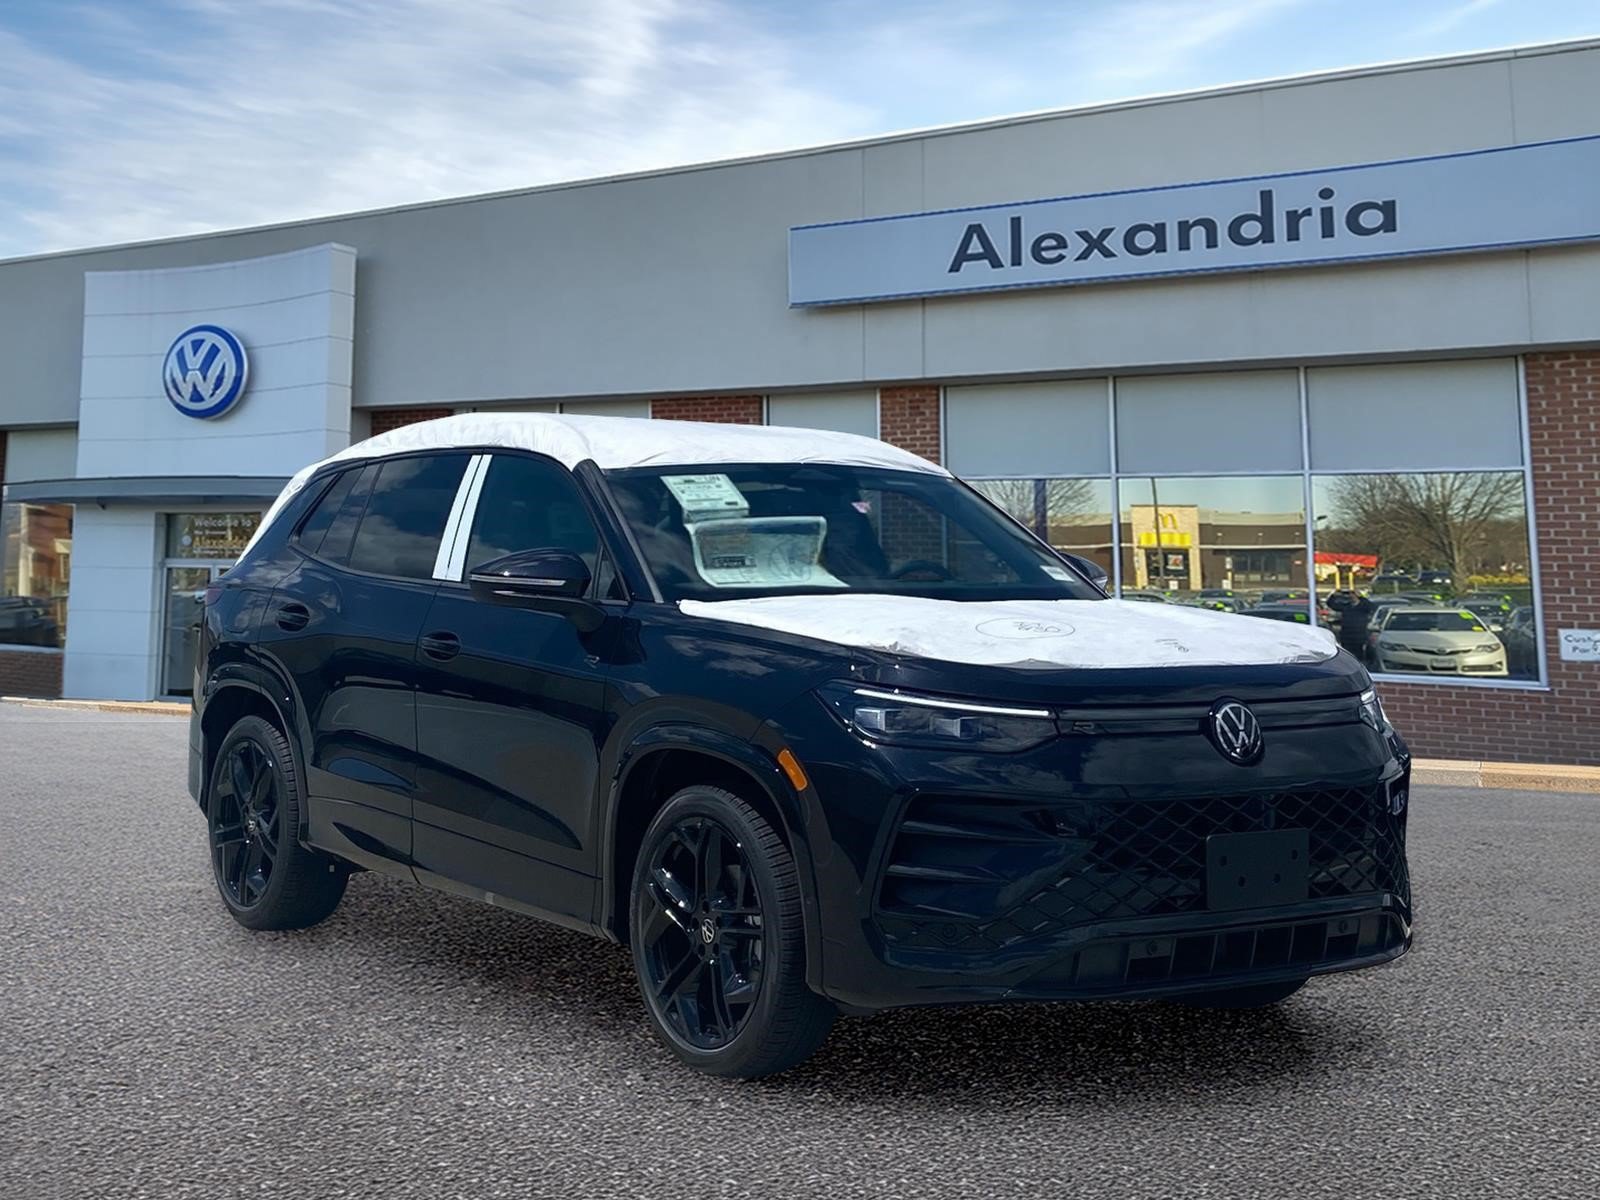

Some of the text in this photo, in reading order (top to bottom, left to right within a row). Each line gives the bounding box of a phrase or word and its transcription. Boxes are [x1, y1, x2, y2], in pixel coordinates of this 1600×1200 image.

[948, 186, 1398, 274] Alexandria
[165, 330, 237, 410] VW
[1215, 702, 1261, 760] VW
